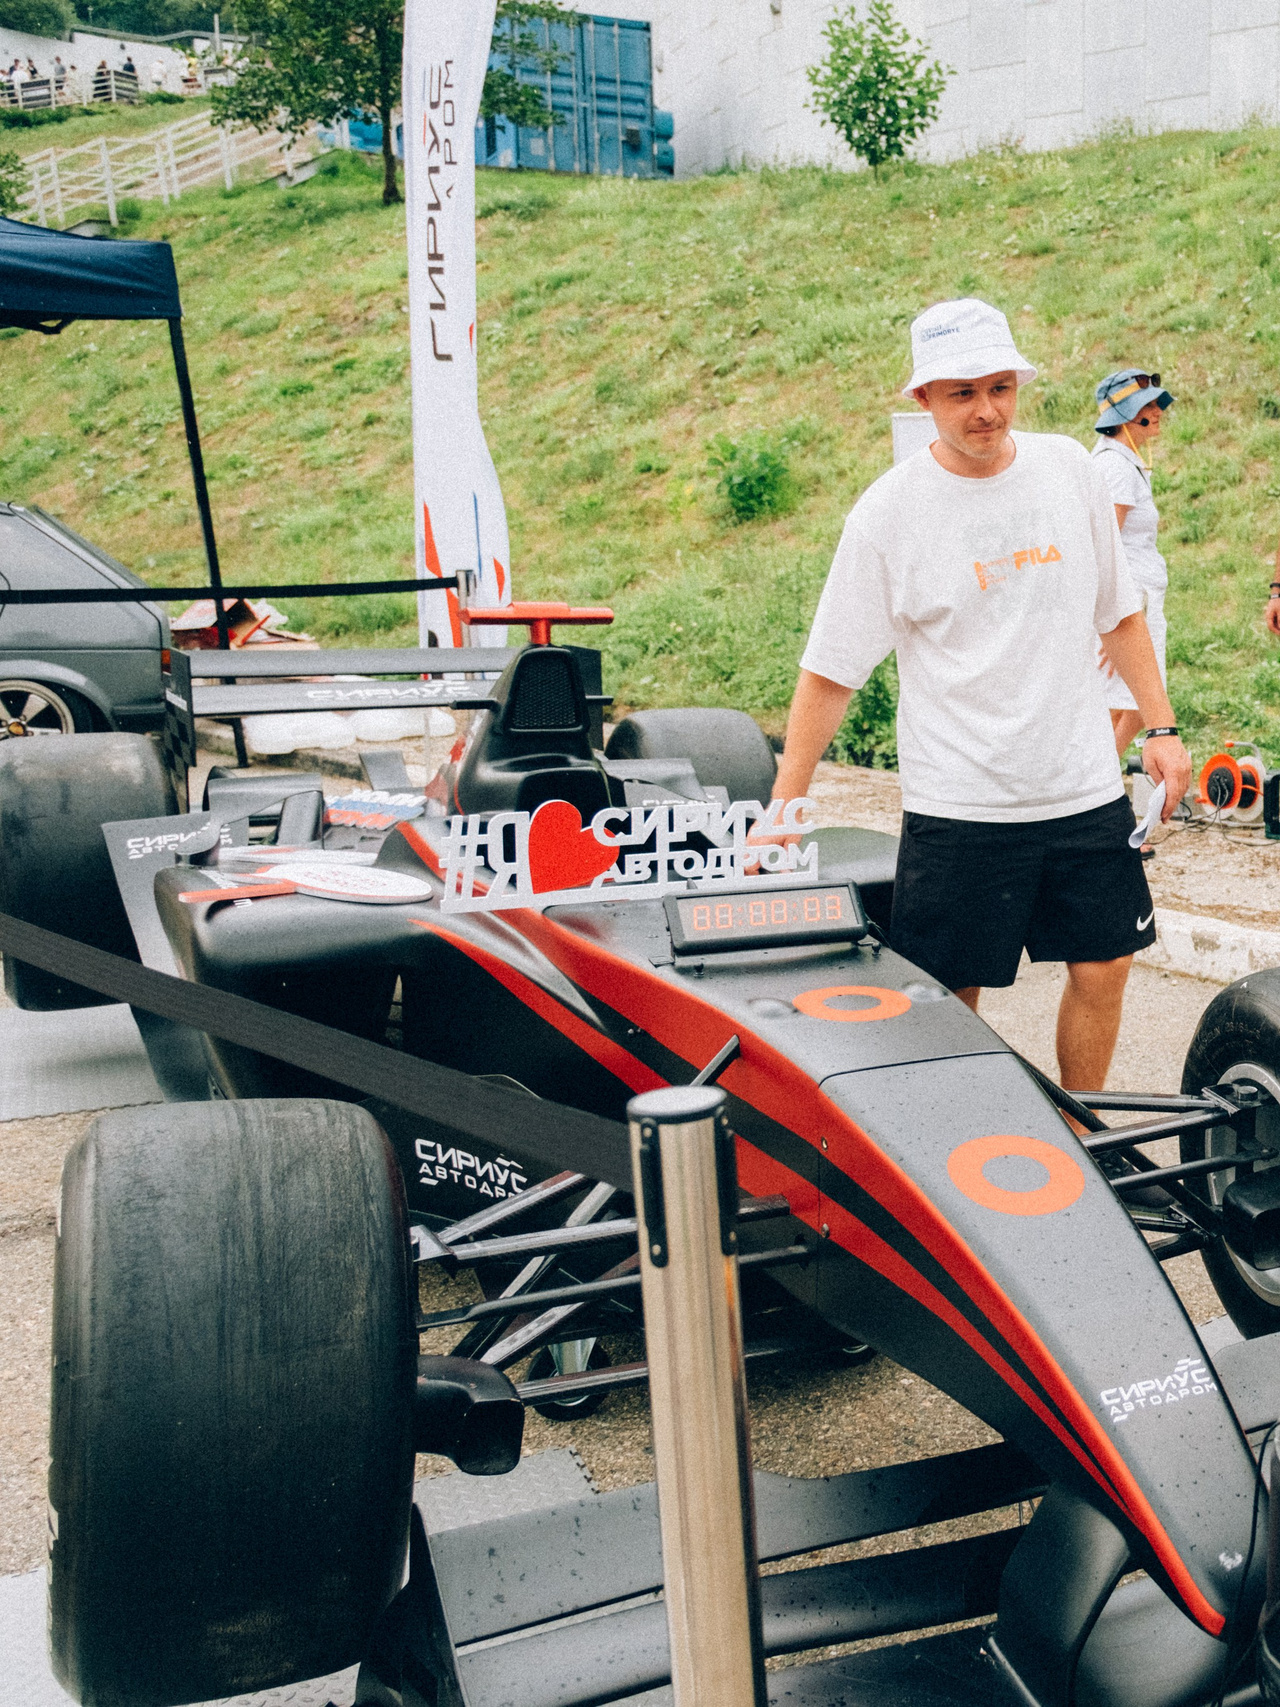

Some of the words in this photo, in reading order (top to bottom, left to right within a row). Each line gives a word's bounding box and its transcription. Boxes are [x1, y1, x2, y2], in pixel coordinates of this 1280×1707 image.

[1013, 544, 1062, 571] FILA
[591, 797, 817, 849] СИРИУС
[438, 811, 532, 900] #Я
[591, 842, 818, 890] АВТОДРОМ
[693, 895, 842, 931] 00:00:03
[414, 1138, 528, 1194] СИРИУС
[418, 1162, 516, 1199] АВТОДР
[1100, 1367, 1211, 1405] СИРИУС
[1110, 1382, 1218, 1416] АВТОДРОМ
